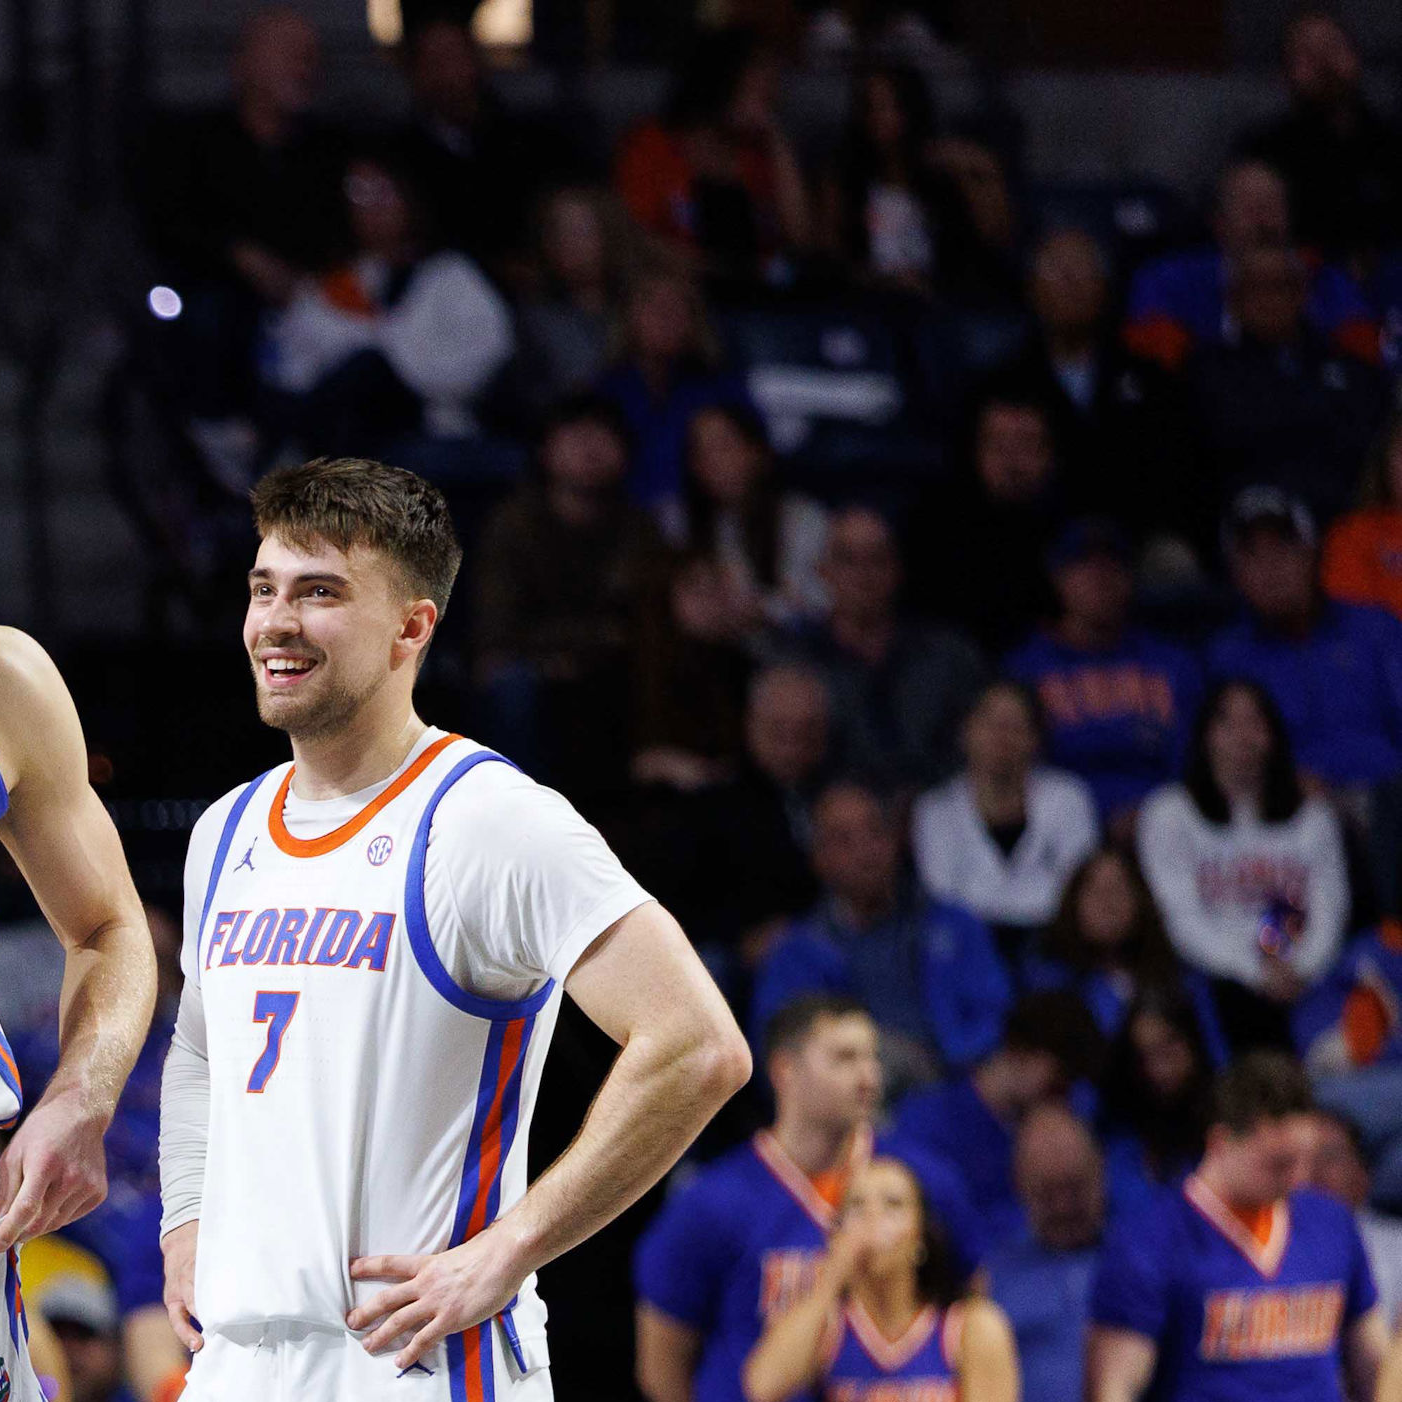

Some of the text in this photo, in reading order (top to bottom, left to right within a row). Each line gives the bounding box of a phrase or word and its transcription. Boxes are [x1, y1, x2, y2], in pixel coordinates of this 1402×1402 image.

[368, 836, 393, 866] SEC
[205, 907, 396, 972] FLORIDA
[246, 990, 300, 1093] 7
